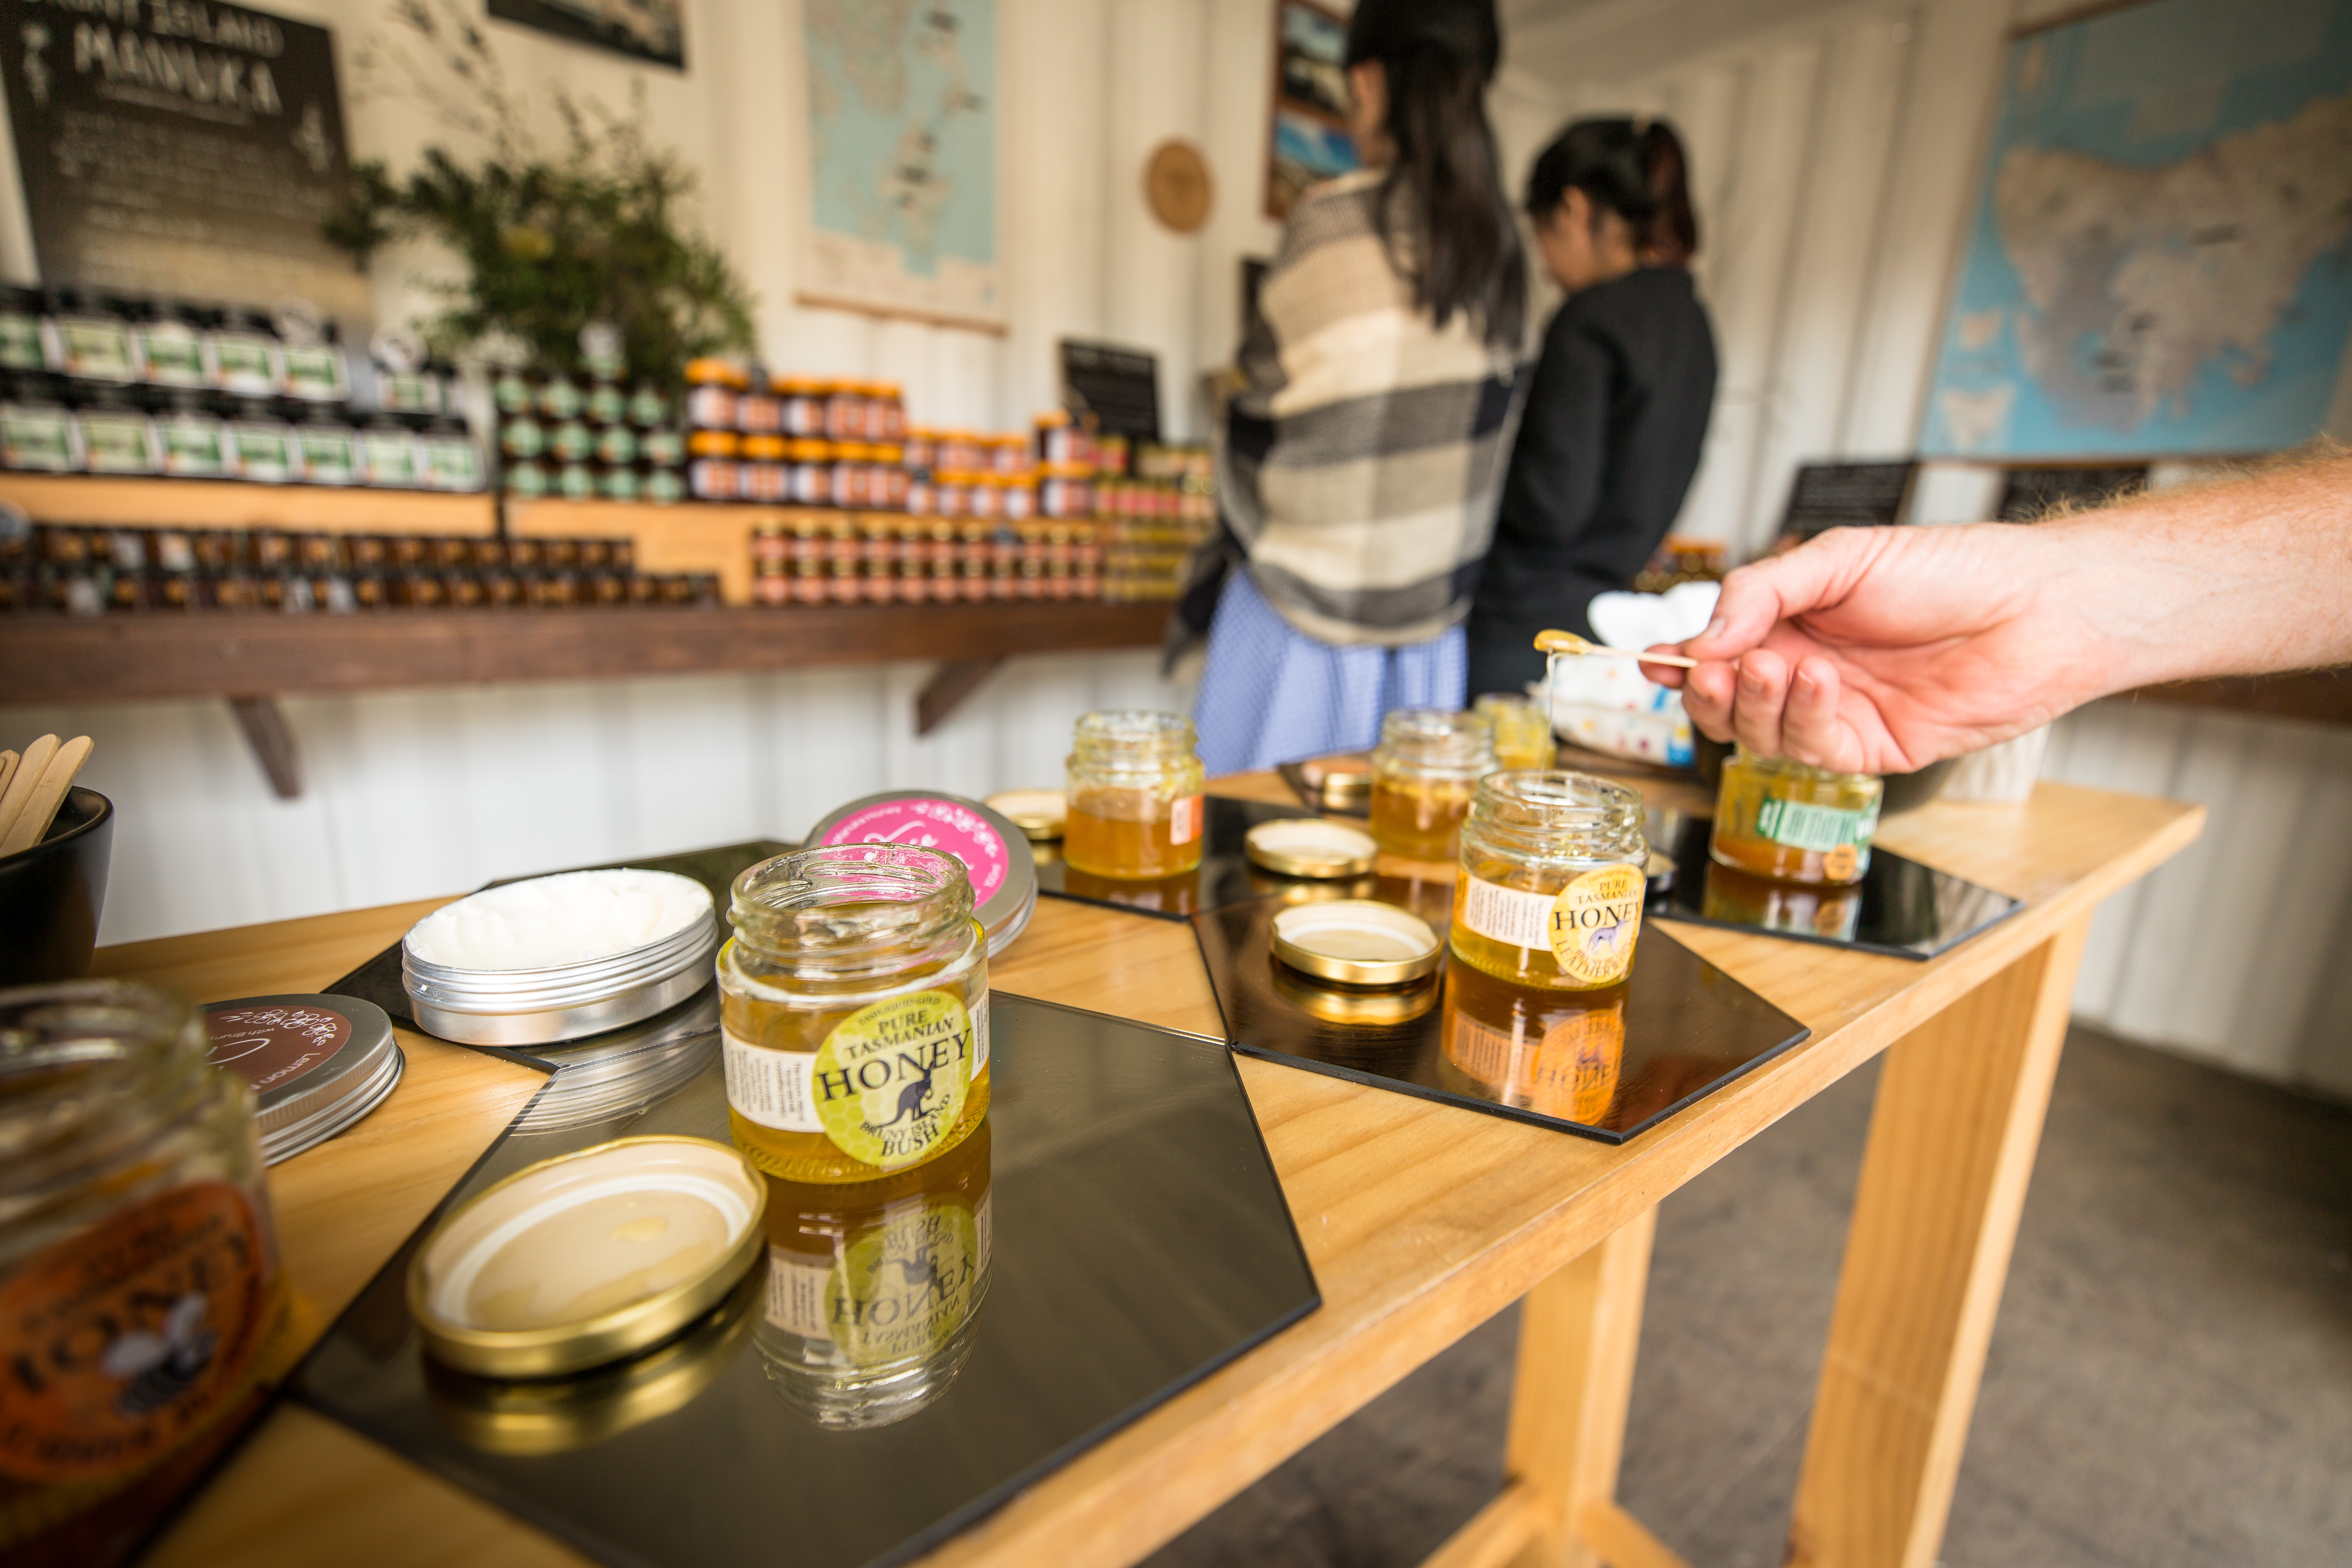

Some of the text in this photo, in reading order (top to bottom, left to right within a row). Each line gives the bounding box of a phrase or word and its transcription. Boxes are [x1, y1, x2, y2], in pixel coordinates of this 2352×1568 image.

[73, 20, 283, 116] MANUKA
[1575, 889, 1639, 904] TASMANIAN
[1599, 880, 1628, 891] PURE
[1553, 901, 1643, 931] HONEY
[248, 1027, 275, 1036] with
[844, 1016, 954, 1059] TASMANIAN
[877, 1009, 928, 1034] PURE
[260, 1052, 322, 1084] Lemon
[814, 1028, 972, 1102] HONEY
[859, 1093, 951, 1141] BRUNY ISLAND
[880, 1124, 940, 1157] BUSH
